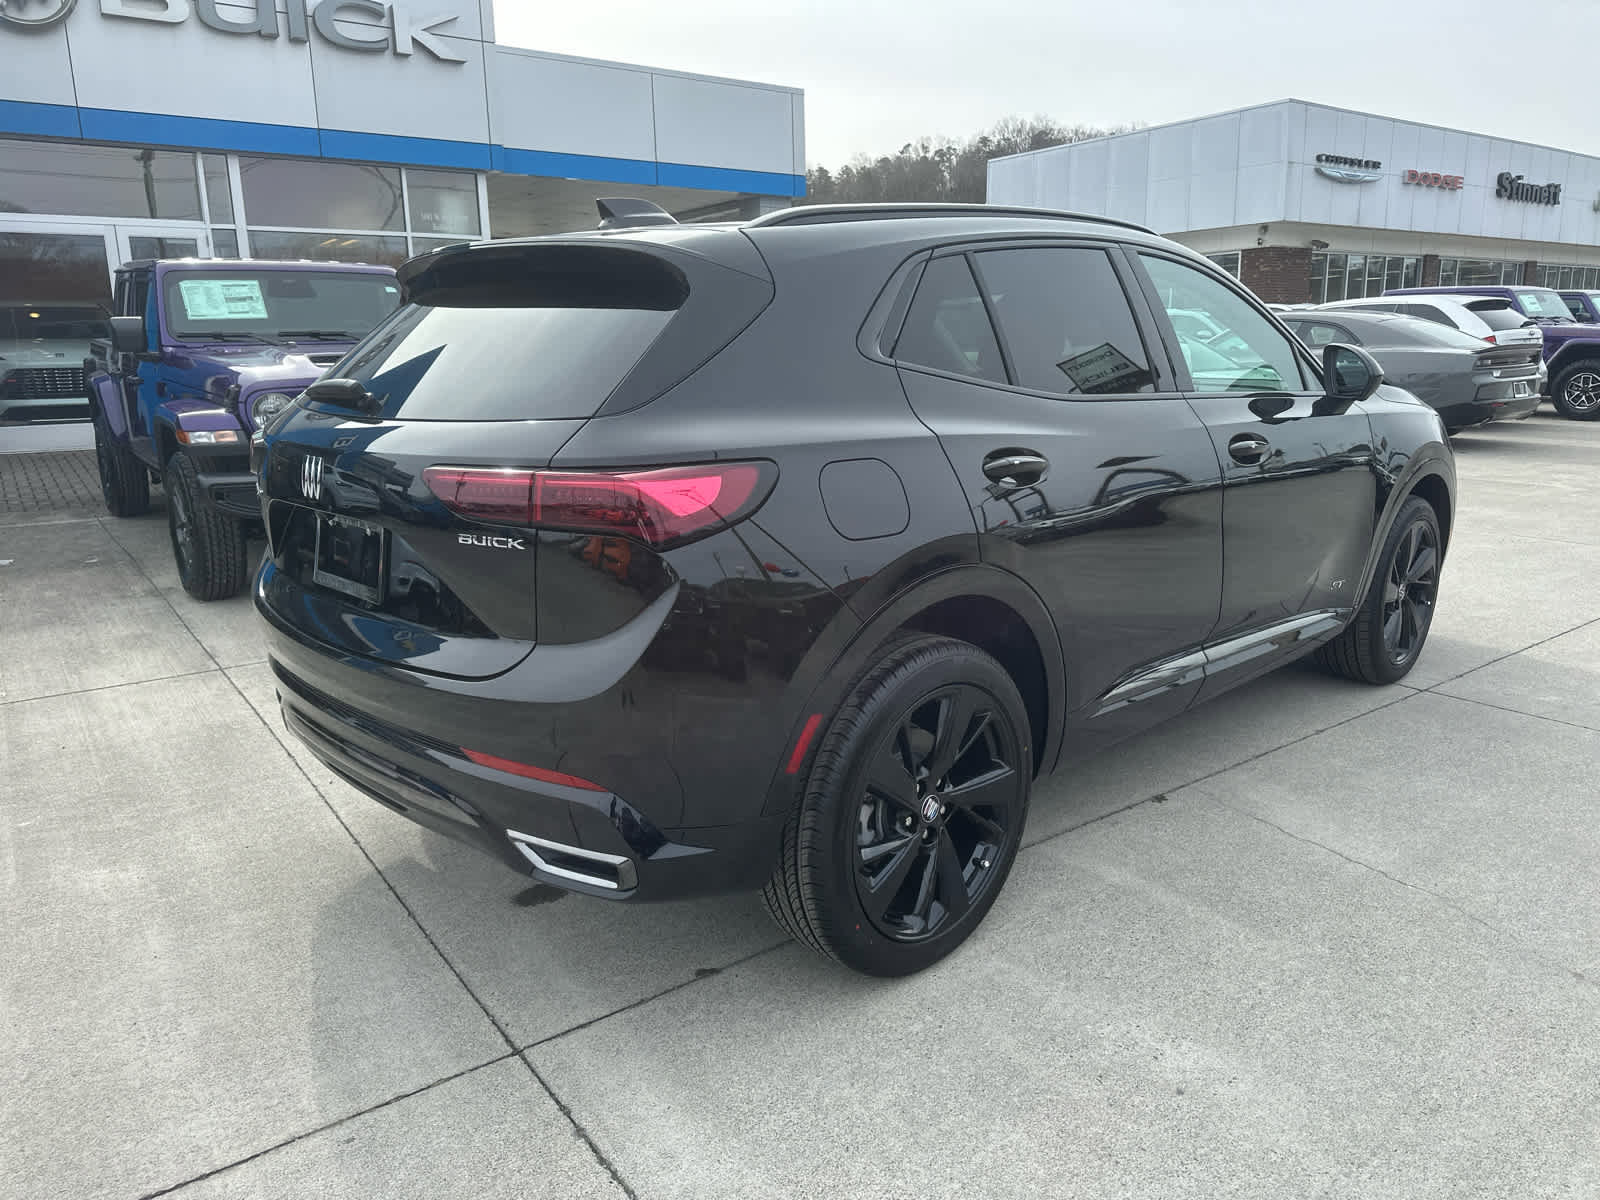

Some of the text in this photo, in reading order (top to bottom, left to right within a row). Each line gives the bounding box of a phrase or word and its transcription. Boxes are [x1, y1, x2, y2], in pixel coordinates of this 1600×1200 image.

[1404, 169, 1465, 190] DODGE
[1496, 171, 1562, 206] Stinnett
[458, 533, 526, 550] BUICK
